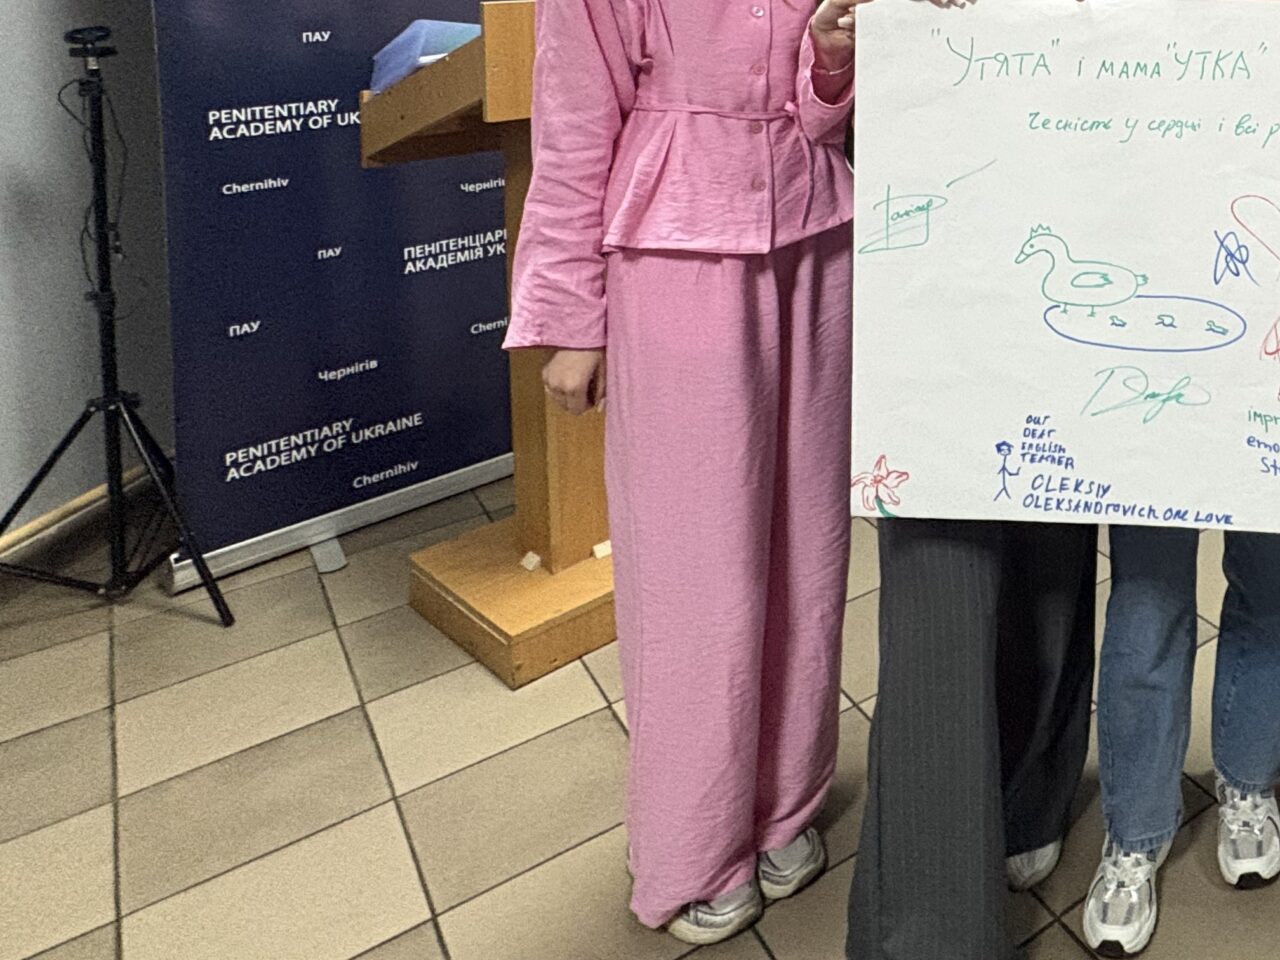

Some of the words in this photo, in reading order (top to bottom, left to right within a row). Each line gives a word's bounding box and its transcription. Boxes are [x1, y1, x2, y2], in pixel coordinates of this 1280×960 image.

[302, 31, 331, 43] ПАУ
[208, 99, 339, 125] PENITENTIARY
[209, 118, 304, 141] ACADEMY
[308, 114, 332, 129] OF
[337, 111, 361, 126] UK
[222, 177, 289, 195] Chernihiv
[317, 245, 342, 260] ПАУ
[403, 229, 507, 260] ПЕНІТЕНЦІАР
[404, 248, 483, 274] АКАДЕМІЯ
[487, 242, 506, 257] УК
[229, 320, 261, 337] ПАУ
[470, 317, 508, 334] Cherni
[318, 358, 378, 382] Чернігів
[225, 418, 353, 466] PENITENTIARY
[225, 443, 319, 482] ACADEMY
[322, 435, 347, 452] OF
[351, 412, 423, 443] UKRAINE
[353, 460, 419, 488] Chernihiv
